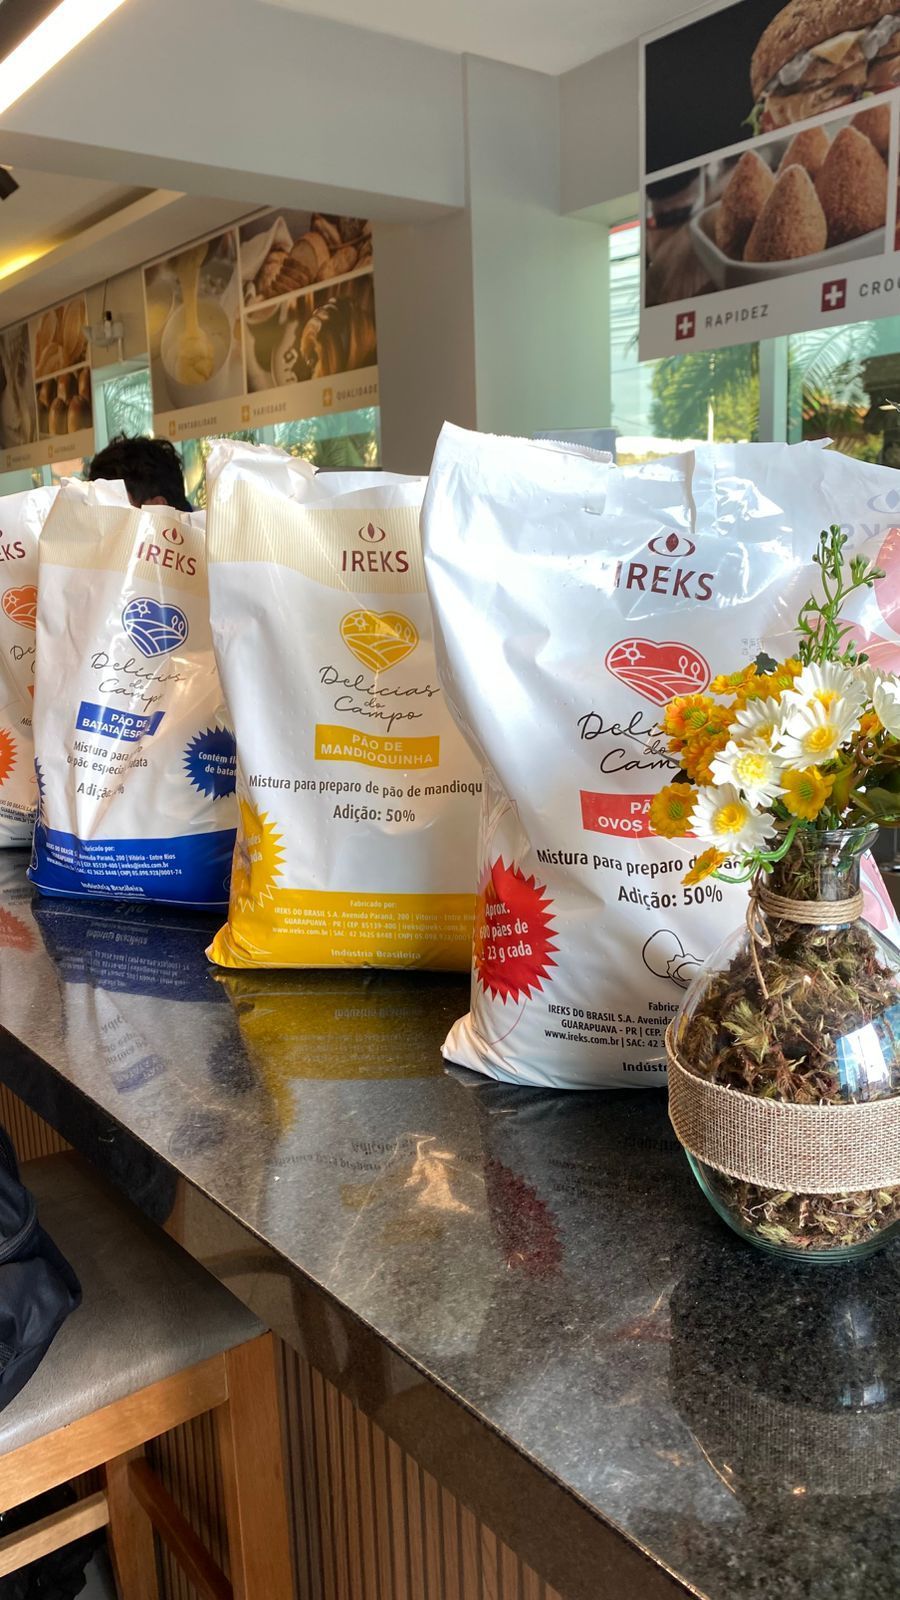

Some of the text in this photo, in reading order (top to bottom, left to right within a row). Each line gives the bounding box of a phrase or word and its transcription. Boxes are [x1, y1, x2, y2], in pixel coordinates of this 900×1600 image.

[705, 304, 769, 328] RAPIDEZ
[336, 384, 378, 400] QUALIDADE
[136, 541, 197, 576] IREKS
[341, 549, 409, 573] IREKS
[613, 561, 714, 601] IREKS
[318, 665, 441, 698] Delicias
[363, 697, 386, 709] do
[111, 713, 133, 727] PÃO
[333, 695, 423, 733] Campo
[82, 718, 120, 735] BATATA
[73, 740, 108, 758] Mistura
[352, 733, 404, 752] PÃO DE
[198, 751, 228, 764] Contém
[320, 743, 433, 766] MANDIOQUINHA
[204, 763, 215, 774] de
[249, 775, 291, 790] Mistura
[294, 779, 317, 793] para
[319, 780, 362, 796] preparo
[365, 780, 380, 795] de
[382, 784, 404, 799] pão
[407, 781, 421, 798] de
[333, 803, 416, 823] Adição: 50%
[597, 815, 643, 832] OVOS
[537, 848, 589, 865] Mistura
[593, 854, 623, 872] para
[626, 857, 683, 878] preparo
[688, 854, 697, 869] d
[618, 884, 723, 911] Adição: 50%
[485, 902, 511, 920] Aprox.
[492, 923, 513, 942] pães
[514, 918, 529, 935] de
[487, 945, 497, 960] 23
[498, 947, 506, 963] g
[507, 940, 533, 958] cada
[548, 1004, 571, 1016] IREKS
[573, 1007, 585, 1018] DO
[586, 1011, 616, 1023] BRASIL
[617, 1014, 635, 1024] S.A.
[561, 1019, 618, 1034] GUARAPUAVA
[625, 1027, 638, 1036] PR
[645, 1028, 662, 1037] CEP.
[544, 1029, 619, 1046] www.ireks.com.br
[626, 1038, 646, 1048] SAC:
[647, 1039, 659, 1048] 42
